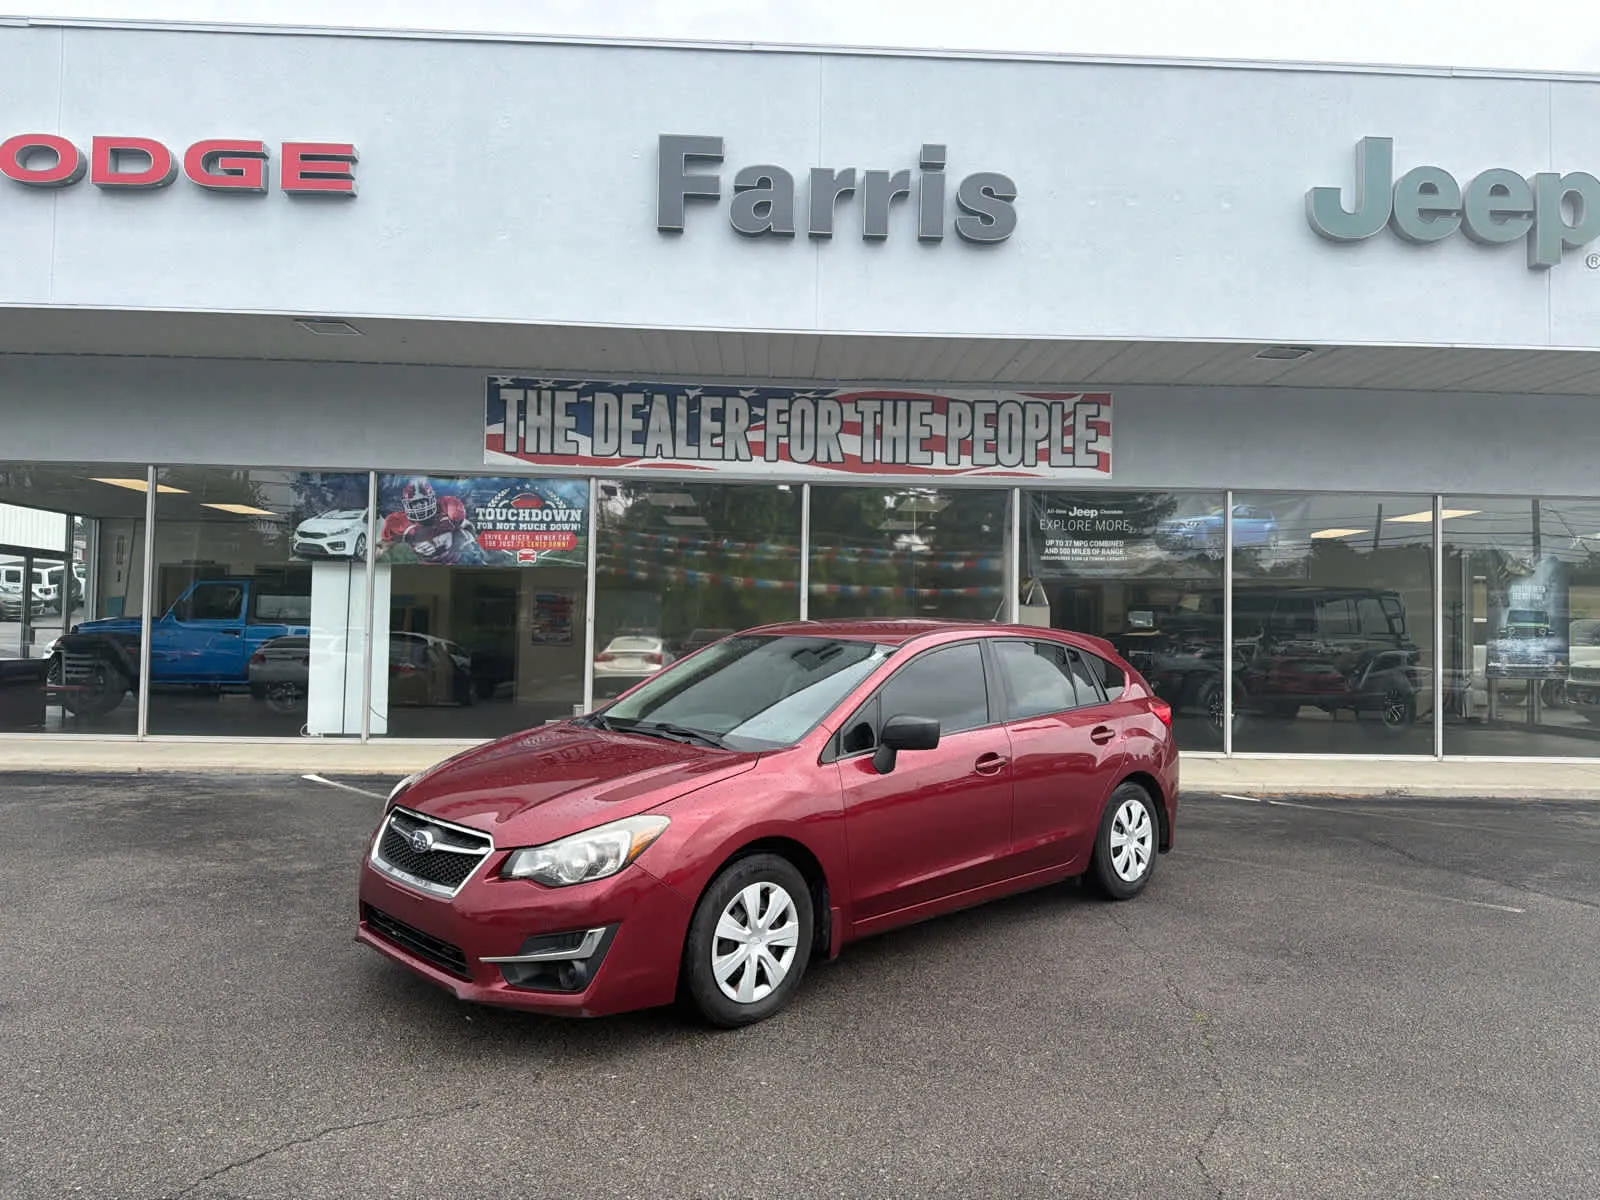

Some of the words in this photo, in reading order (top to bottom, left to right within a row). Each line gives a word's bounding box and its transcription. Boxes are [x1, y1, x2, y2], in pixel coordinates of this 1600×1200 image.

[0, 133, 357, 198] ODGE
[657, 133, 1018, 244] Farris
[1305, 136, 1600, 270] Jeep
[499, 387, 581, 456] THE
[591, 391, 754, 462] DEALER
[764, 395, 845, 464] FOR
[854, 398, 934, 465] THE
[945, 399, 1100, 468] PEOPLE
[475, 508, 582, 522] TOUCHDOWN
[1068, 506, 1098, 519] Jeep
[477, 522, 493, 530] FOR
[495, 522, 515, 530] NOT
[519, 523, 547, 531] MUCH
[549, 523, 581, 531] DOWN!
[1039, 519, 1092, 531] EXPLORE
[1089, 540, 1124, 548] COMBINED
